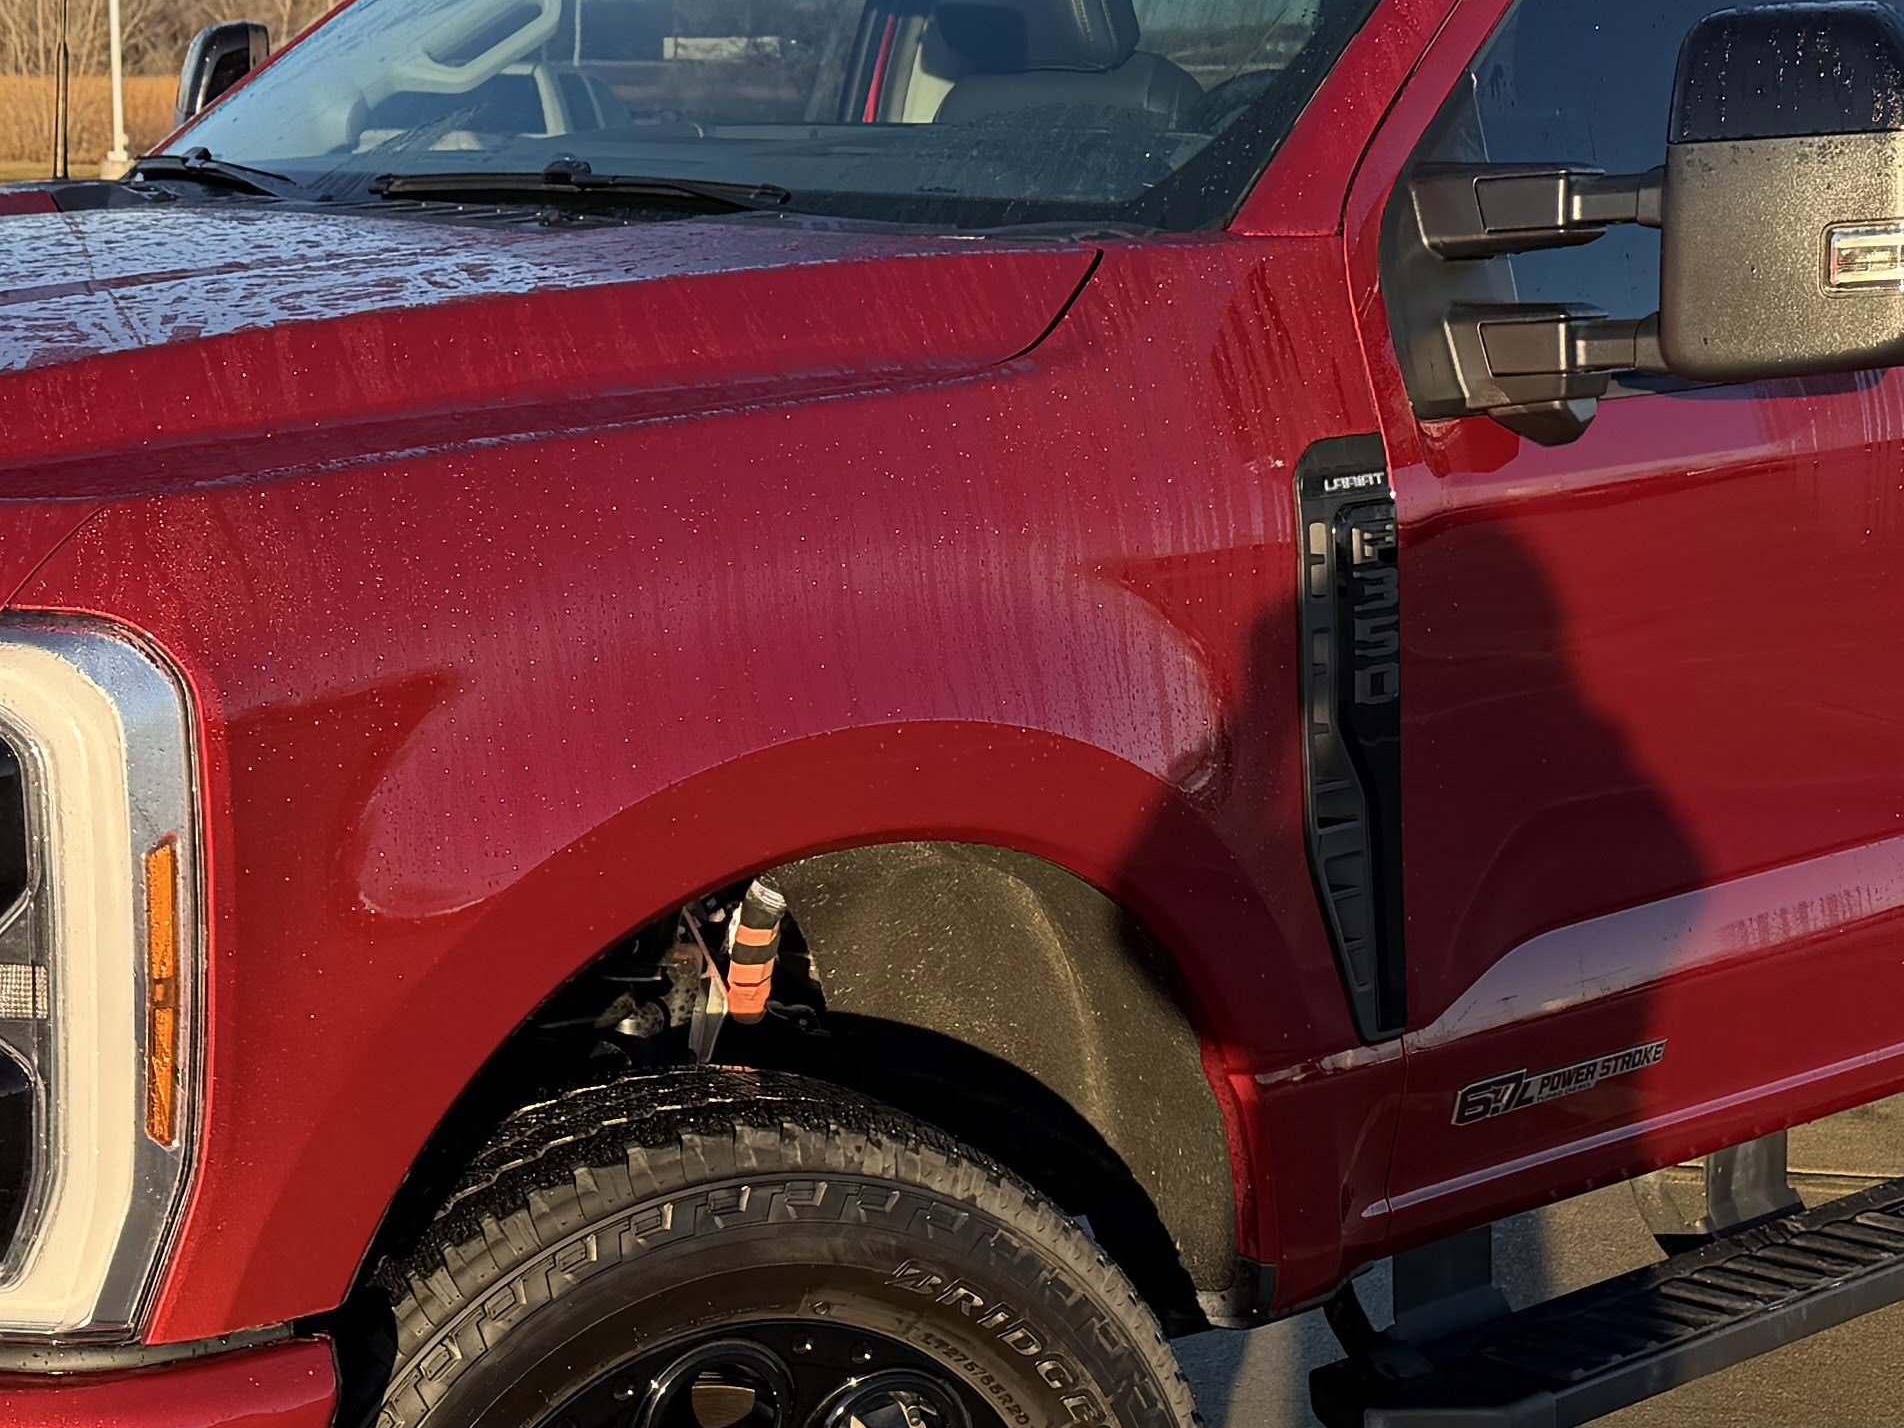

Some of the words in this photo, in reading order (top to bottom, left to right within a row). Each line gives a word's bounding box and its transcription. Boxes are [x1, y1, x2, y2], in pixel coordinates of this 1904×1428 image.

[1324, 471, 1385, 493] LARIAT
[1538, 1064, 1598, 1095] POWER
[1599, 1042, 1667, 1079] STROKE
